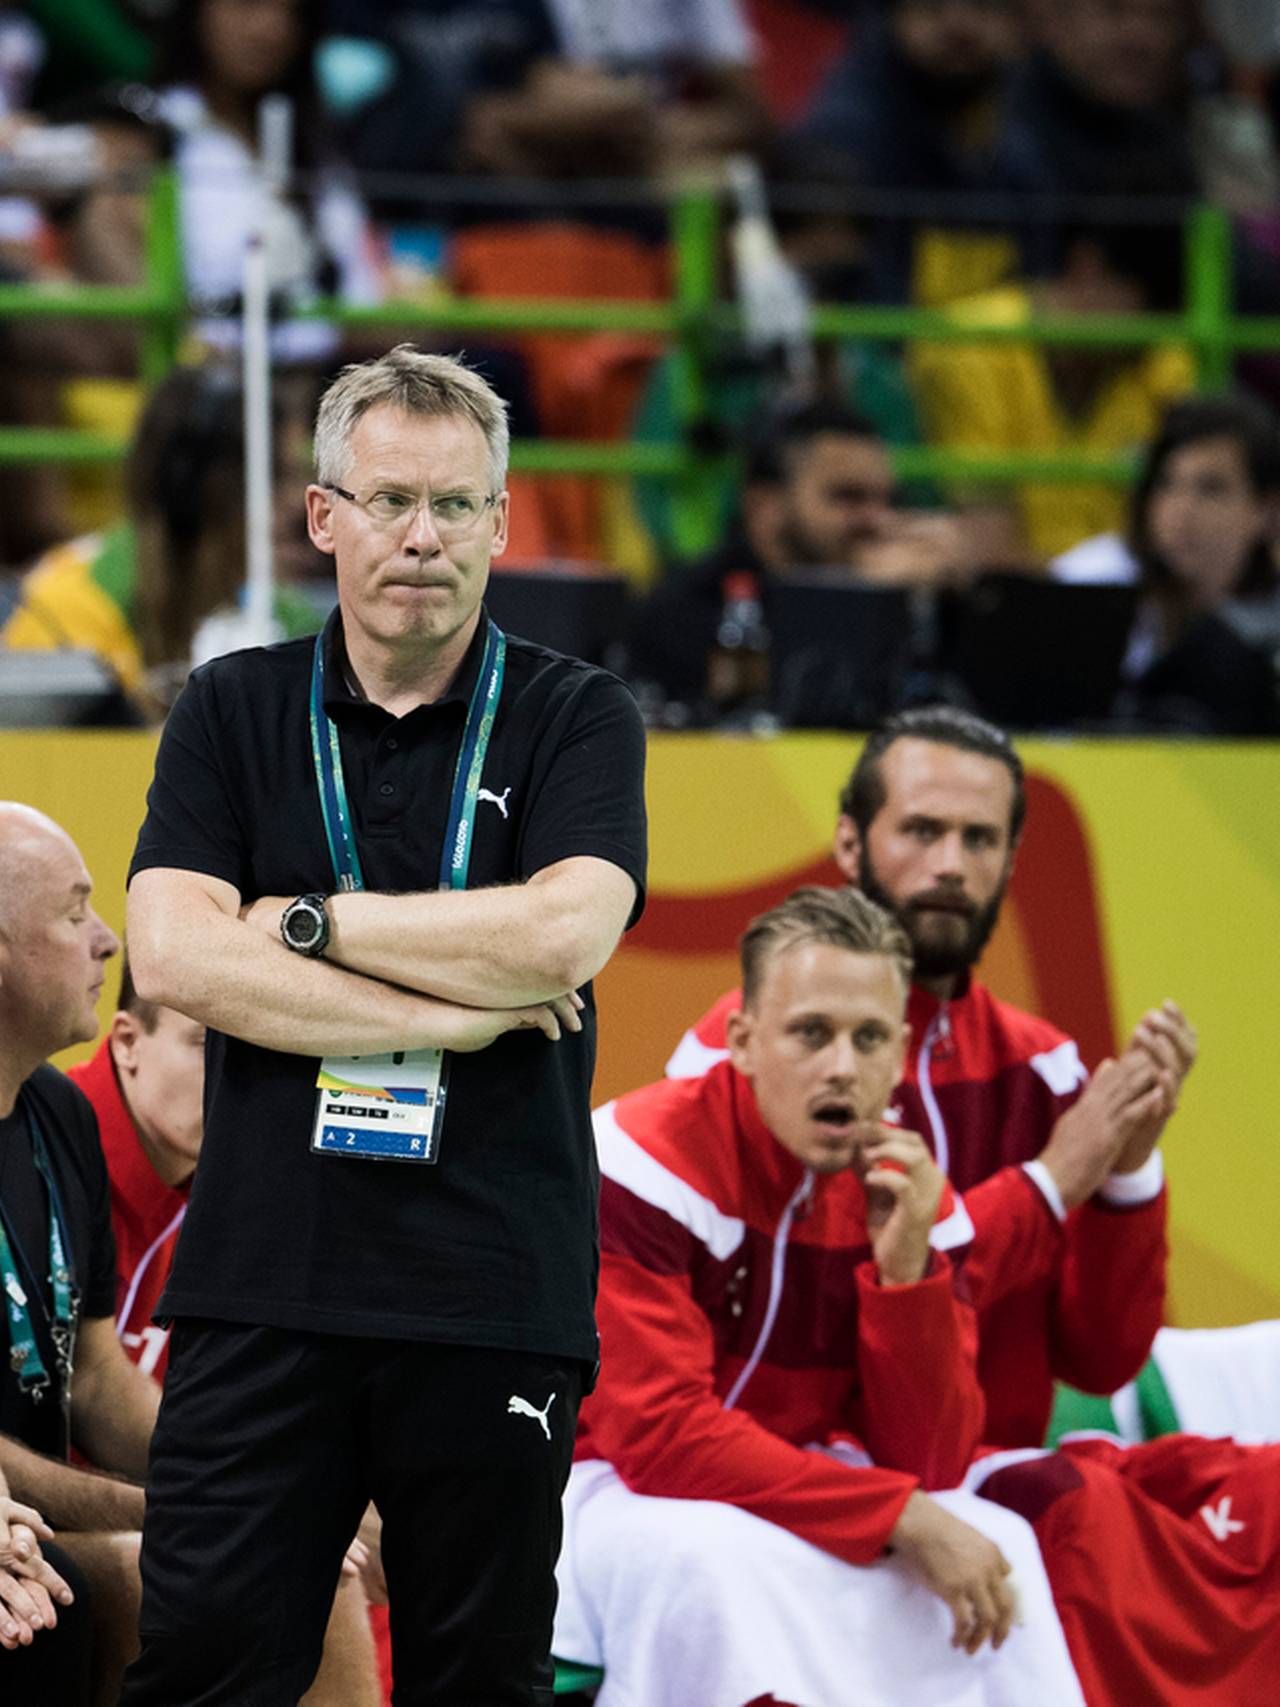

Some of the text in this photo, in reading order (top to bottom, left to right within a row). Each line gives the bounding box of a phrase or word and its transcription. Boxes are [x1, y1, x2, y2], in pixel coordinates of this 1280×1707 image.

[326, 1131, 421, 1151] A 2 R
